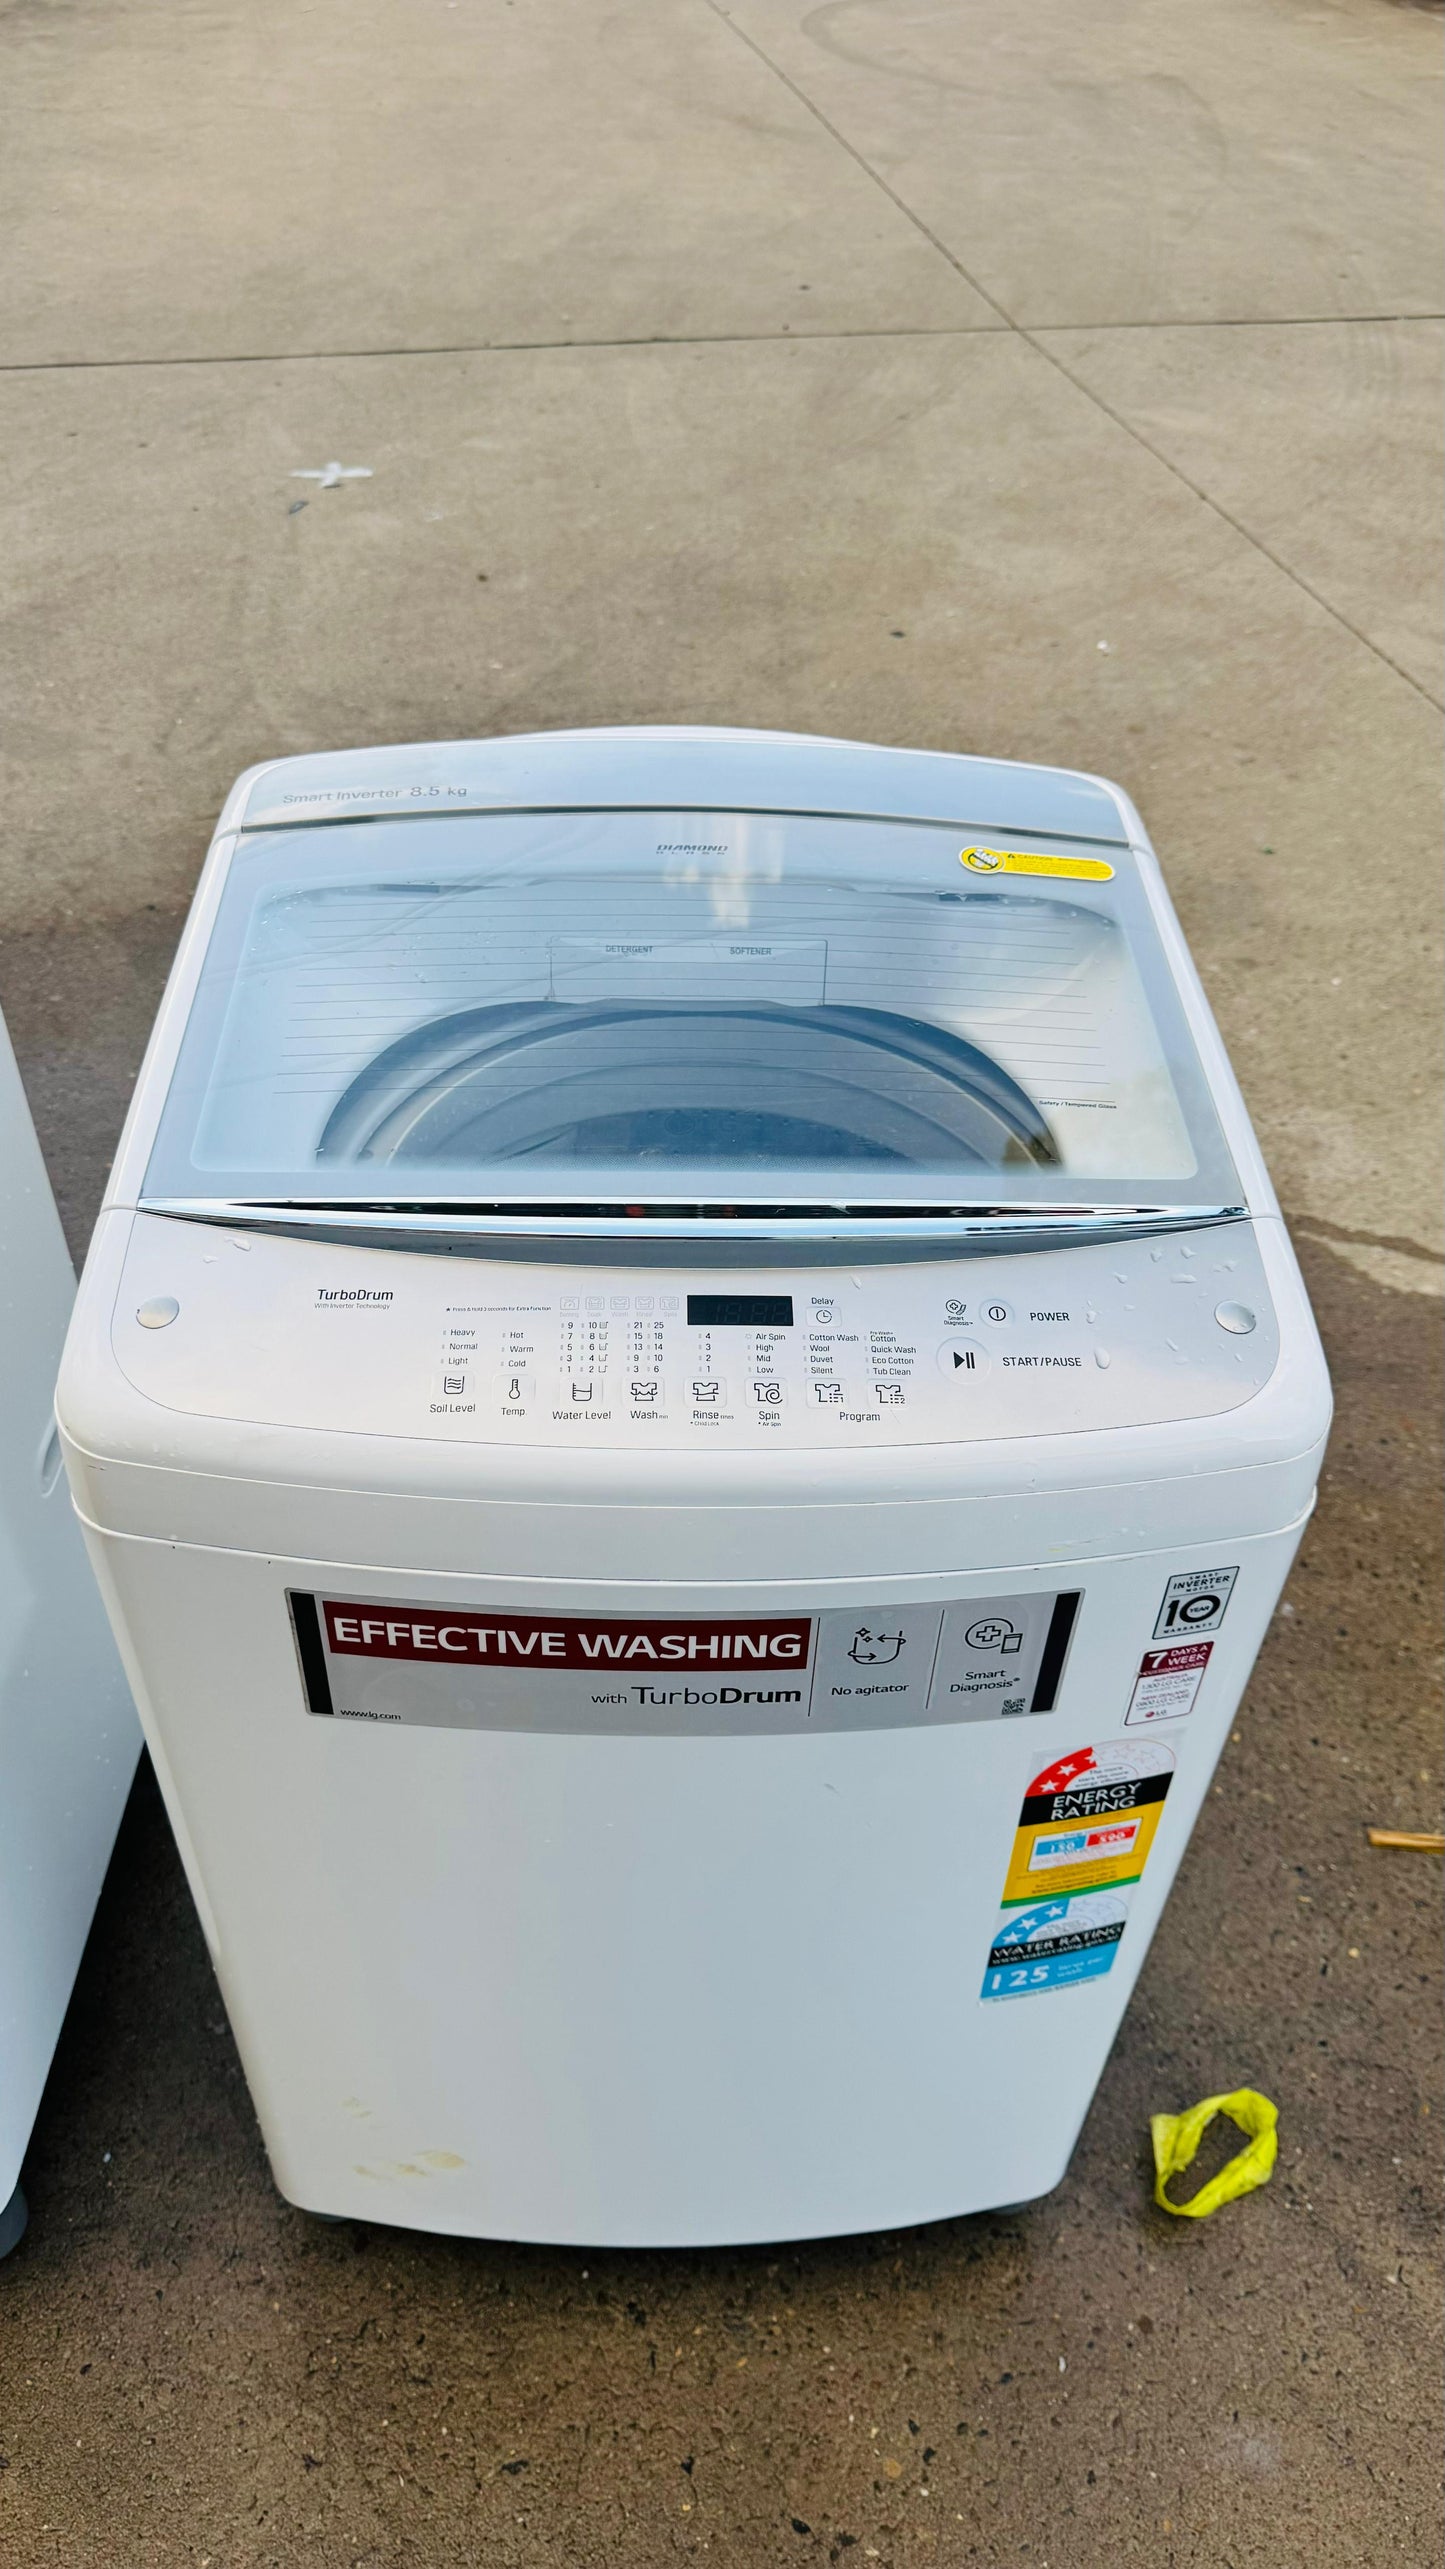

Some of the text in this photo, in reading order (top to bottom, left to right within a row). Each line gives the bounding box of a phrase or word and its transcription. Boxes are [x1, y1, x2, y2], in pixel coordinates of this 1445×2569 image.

[283, 786, 468, 804] Smart Inverter 8.5 kg
[605, 944, 653, 954] DETERGENT
[730, 946, 772, 956] SOFTENER
[317, 1288, 394, 1301] TurboDrum
[811, 1297, 834, 1306] Delay
[1030, 1312, 1070, 1321] POWER
[567, 1321, 597, 1329] 9 10
[634, 1321, 664, 1329] 21 25
[450, 1329, 475, 1337] Heavy
[510, 1331, 523, 1339] Hot
[567, 1332, 596, 1340] 7 8
[634, 1332, 664, 1340] 15 18
[755, 1333, 786, 1342] Air Spin
[809, 1333, 859, 1342] Cotton Wash
[870, 1335, 896, 1343] Cotton
[449, 1342, 478, 1350] Normal
[510, 1345, 534, 1353] Warm
[567, 1343, 595, 1351] 5 6
[634, 1343, 643, 1351] 13
[705, 1343, 711, 1351] 3
[756, 1344, 774, 1353] High
[871, 1346, 916, 1354] Quick Wash
[448, 1357, 468, 1366] Light
[566, 1354, 573, 1362] 3
[634, 1354, 664, 1362] 9 10
[705, 1354, 711, 1362] 2
[810, 1355, 834, 1363] Duvet
[872, 1356, 914, 1365] Eco Cotton
[1002, 1356, 1082, 1367] START/PAUSE
[508, 1359, 526, 1368] Cold
[588, 1365, 595, 1373] 2
[633, 1365, 660, 1373] 3 6
[757, 1366, 775, 1374] Low
[810, 1366, 834, 1375] Silent
[873, 1367, 912, 1376] Tub Clean
[429, 1403, 476, 1413] Soil Level
[552, 1411, 612, 1420] Water Level
[630, 1410, 658, 1420] Wash
[692, 1410, 720, 1420] Rinse
[758, 1410, 781, 1421] Spin
[839, 1411, 881, 1423] Program
[1189, 1572, 1219, 1580] SMART
[1173, 1575, 1230, 1590] INVERTER
[1165, 1595, 1221, 1627] 10
[1190, 1605, 1210, 1613] YEAR
[1163, 1622, 1213, 1634] WARRANTY
[333, 1616, 803, 1661] EFFECTIVE WASHING
[1171, 1644, 1208, 1657] DAYS A
[1148, 1651, 1168, 1669] 7
[1167, 1652, 1206, 1666] WEEK
[965, 1669, 1006, 1681] Smart
[831, 1683, 910, 1697] No agitator
[592, 1686, 803, 1706] with TurboDrum
[340, 1708, 402, 1722] www.lg.com
[1053, 1782, 1142, 1808] ENERGY
[1051, 1795, 1136, 1821] RATING
[994, 1942, 1054, 1958] WATER
[991, 1965, 1050, 1990] 125
